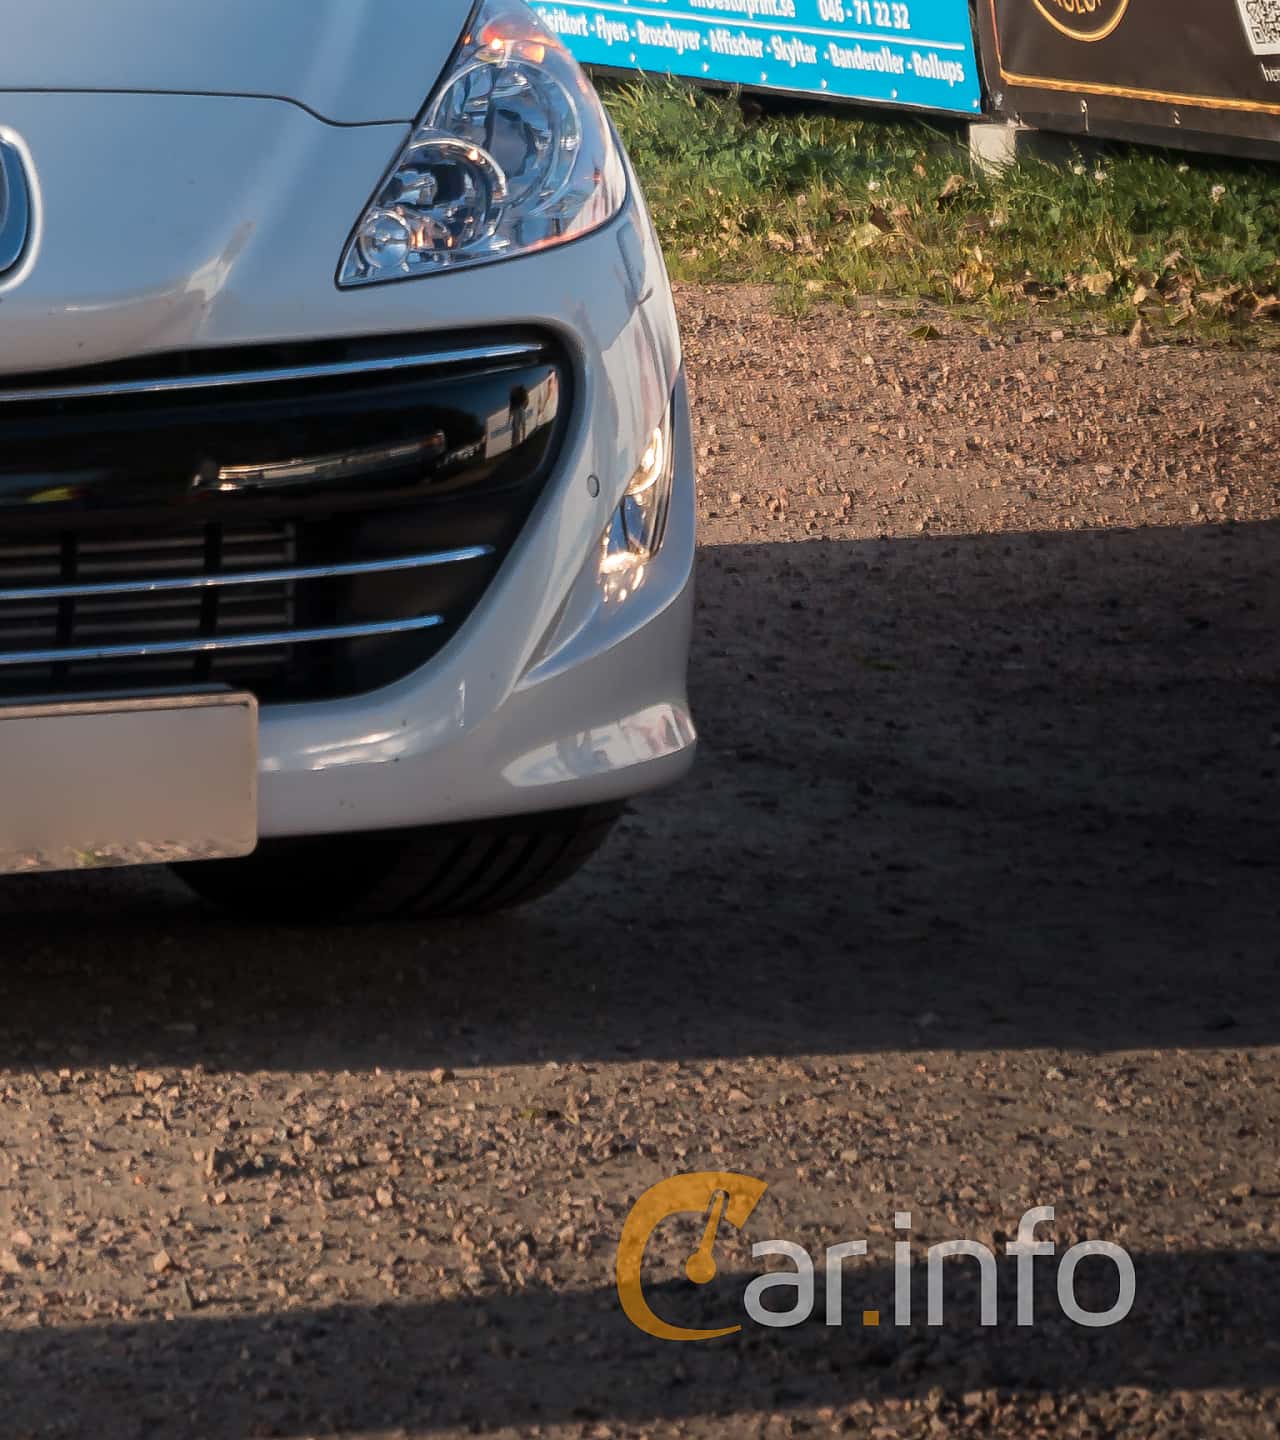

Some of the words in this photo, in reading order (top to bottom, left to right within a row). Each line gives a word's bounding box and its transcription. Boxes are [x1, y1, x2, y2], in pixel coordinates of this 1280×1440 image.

[595, 13, 630, 46] Flyers
[637, 20, 701, 55] Broschyrer
[709, 29, 764, 58] Affischer
[771, 36, 817, 68] Skyltar
[828, 43, 905, 74] Banderoller
[912, 52, 965, 87] Rollups
